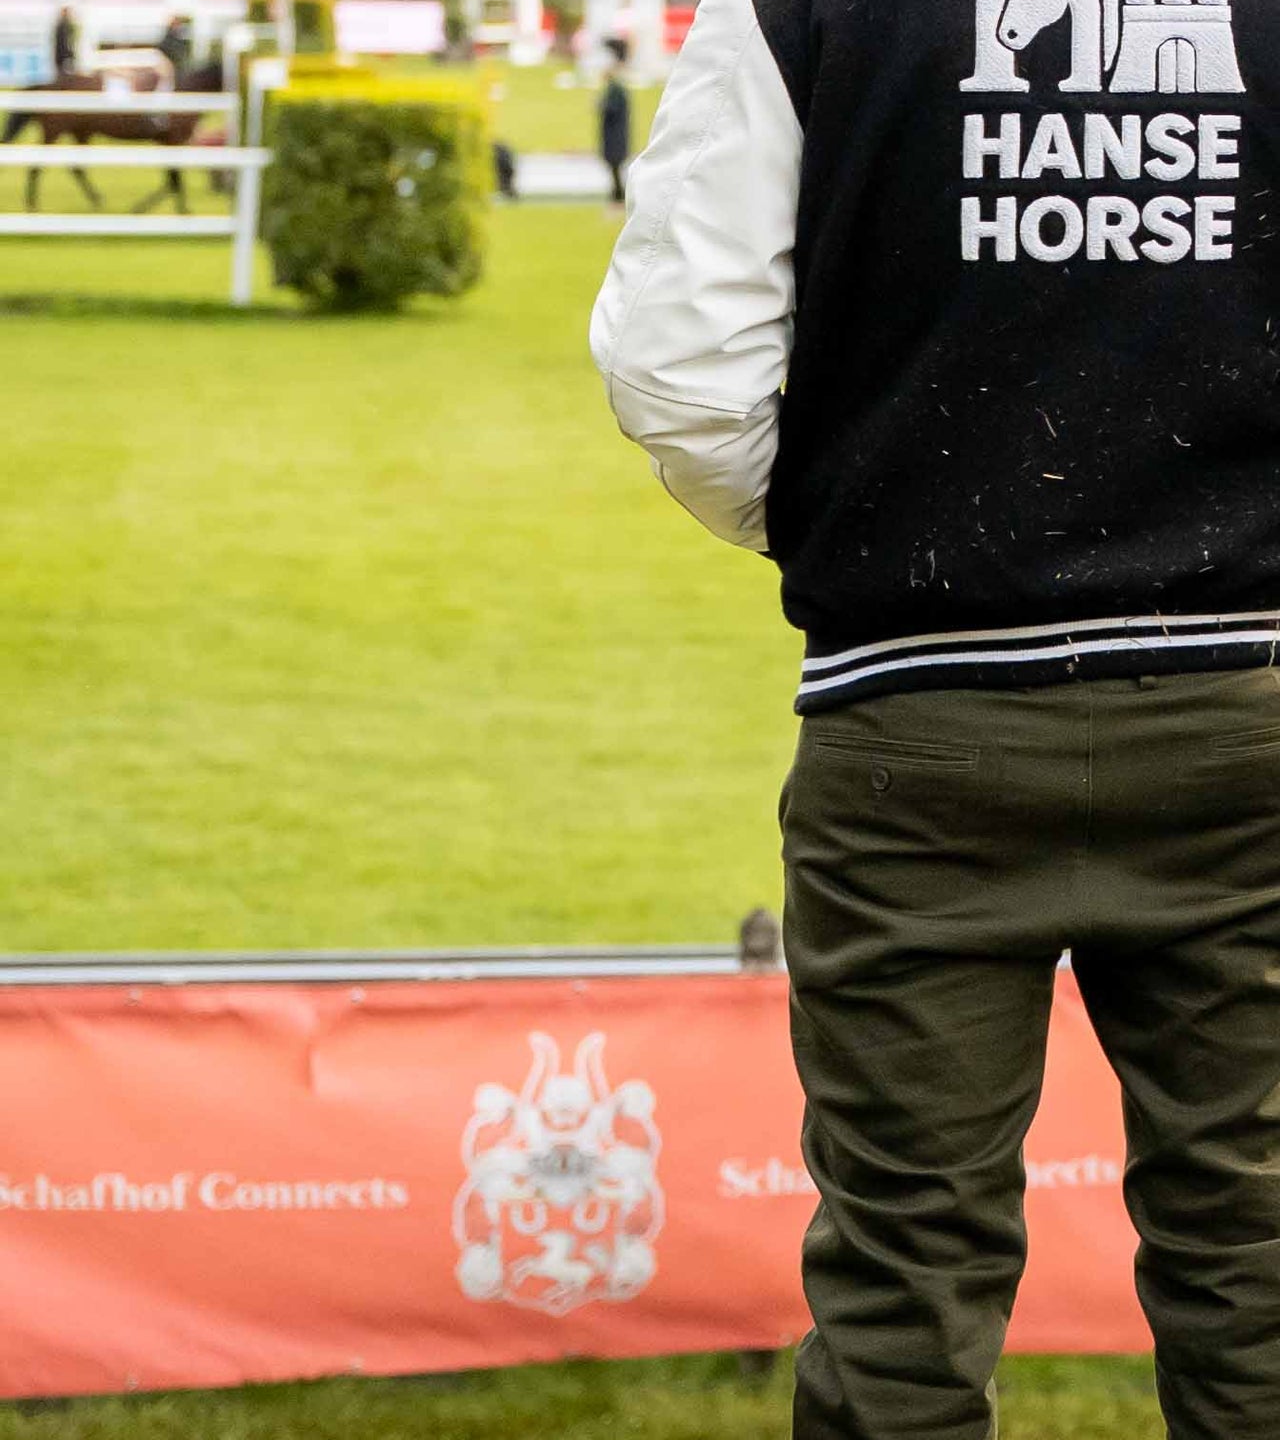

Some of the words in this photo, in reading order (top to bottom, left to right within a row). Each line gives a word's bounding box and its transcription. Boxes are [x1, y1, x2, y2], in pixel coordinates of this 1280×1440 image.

[962, 112, 1242, 182] HANSE
[960, 195, 1236, 264] HORSE
[198, 1172, 410, 1211] Connects
